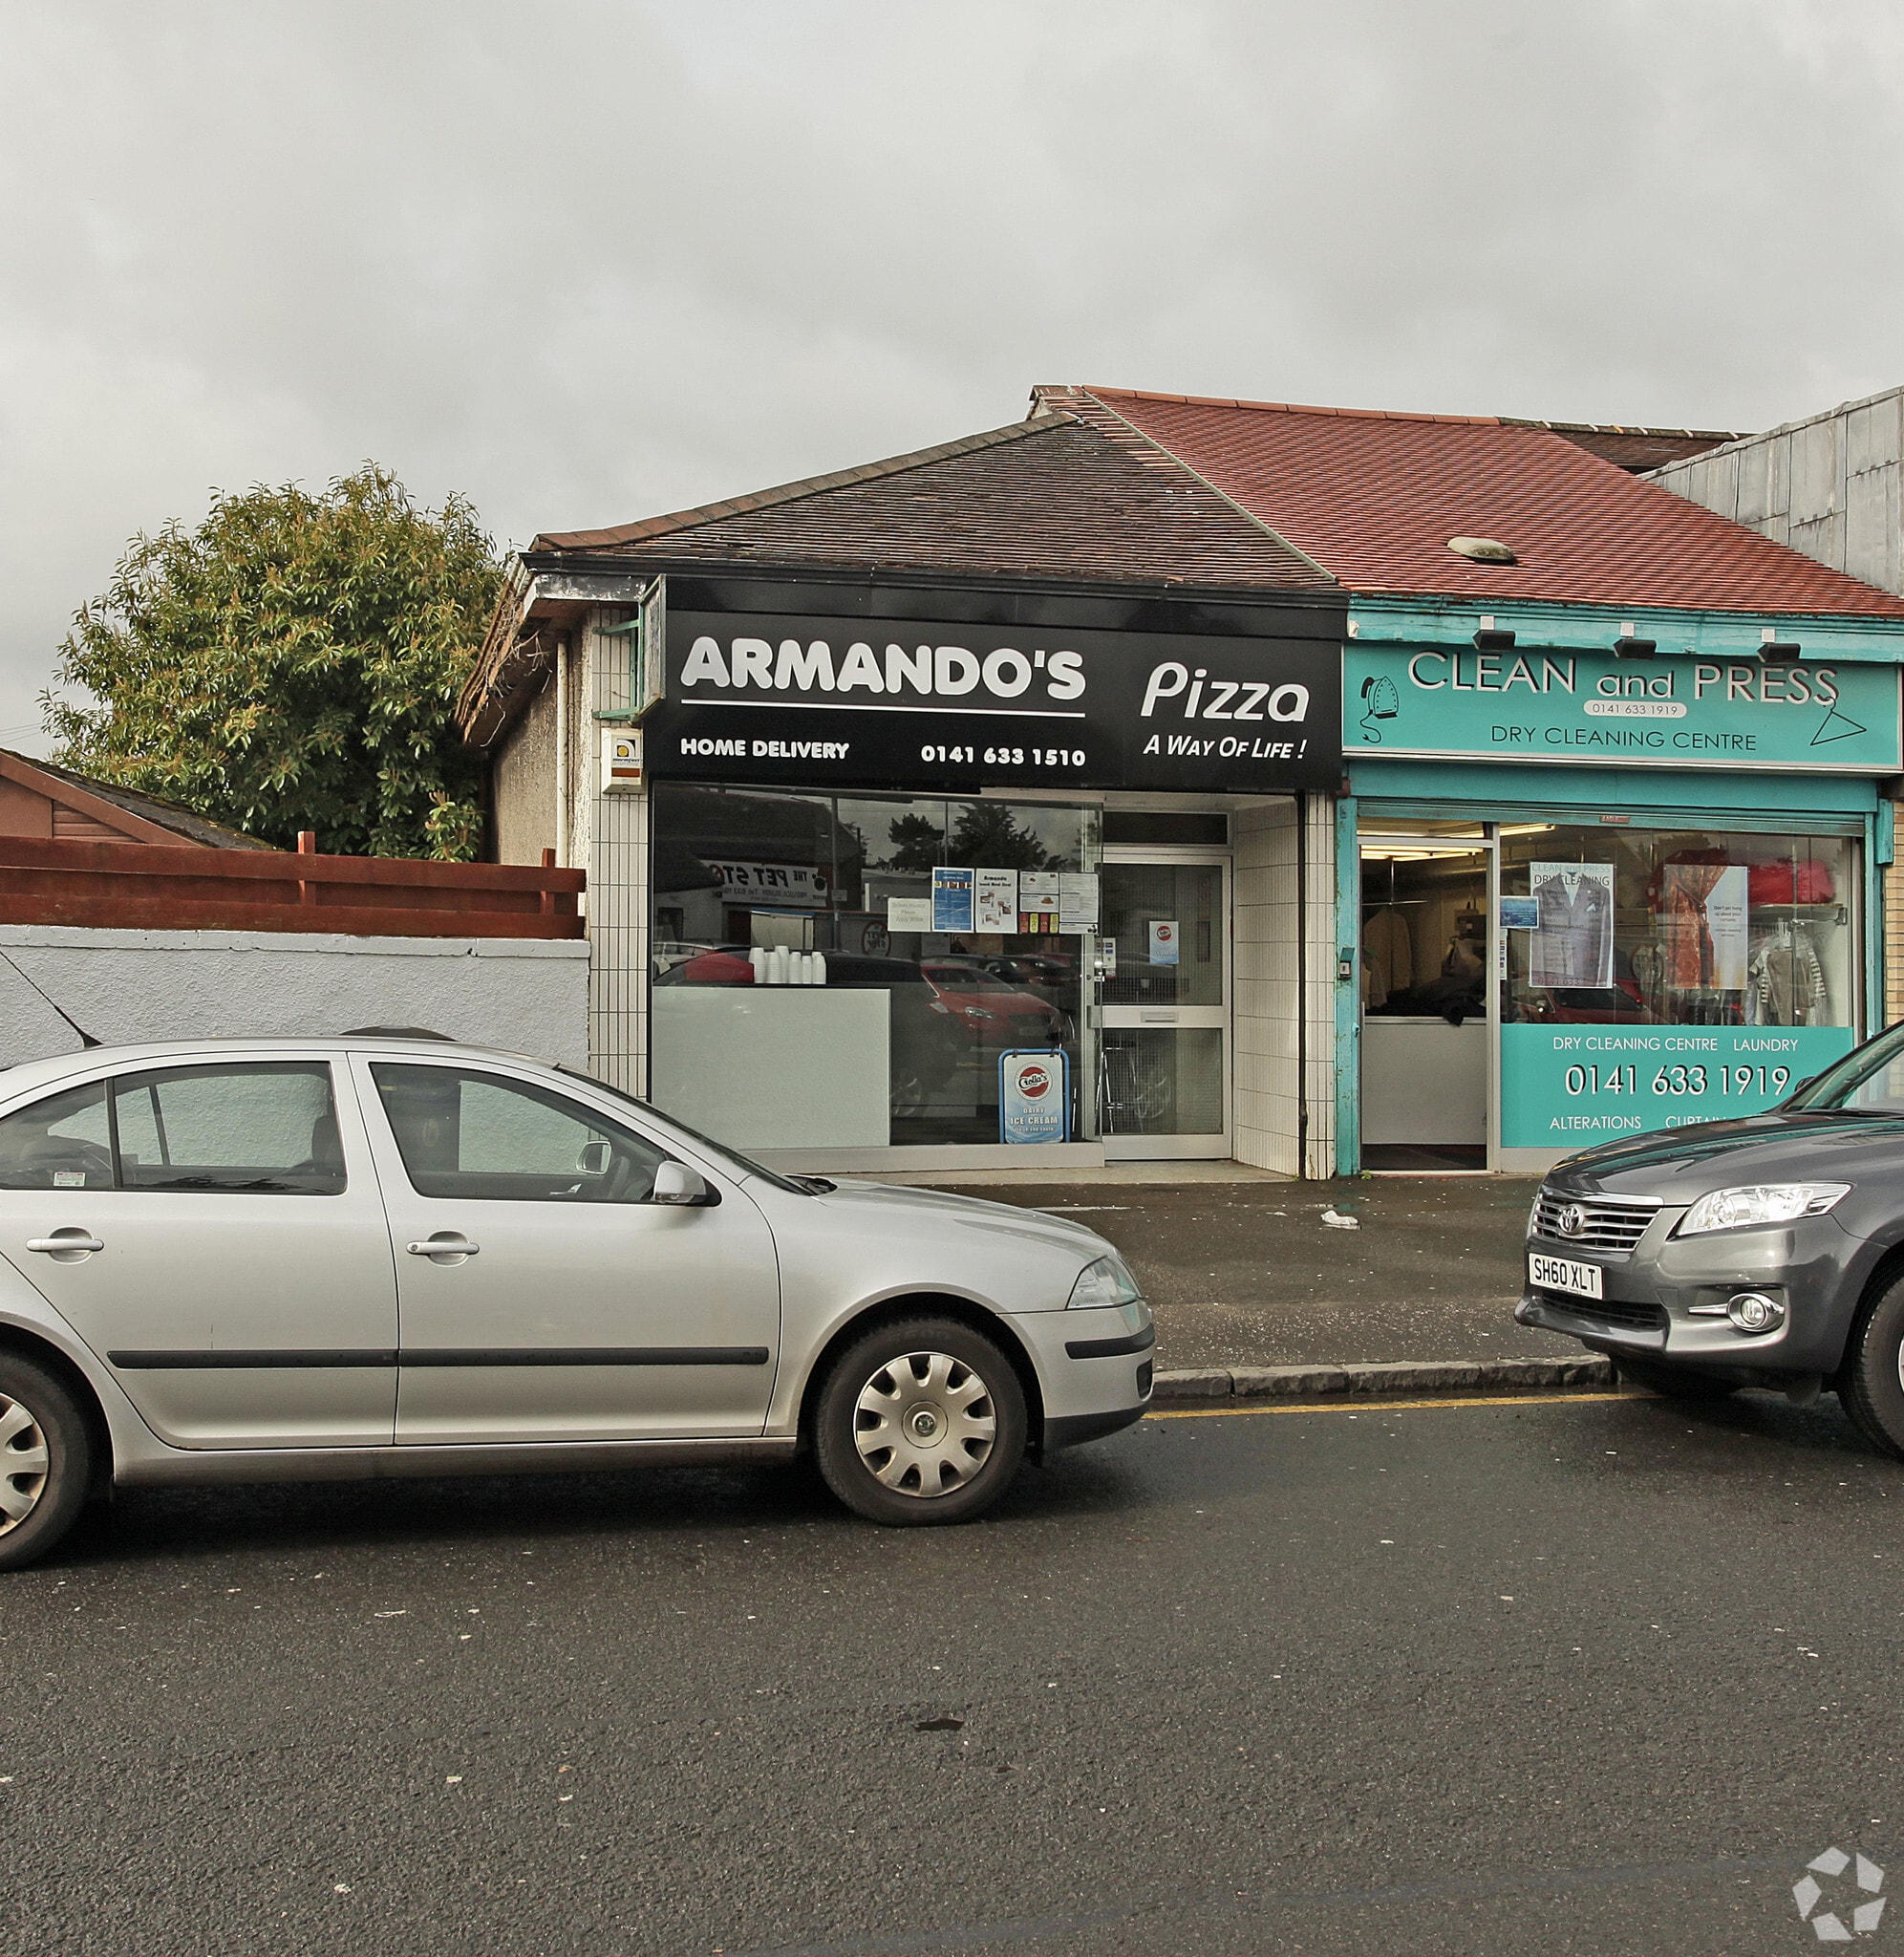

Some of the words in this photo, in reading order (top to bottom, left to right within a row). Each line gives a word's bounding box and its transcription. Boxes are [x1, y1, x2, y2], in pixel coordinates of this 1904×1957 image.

[680, 635, 1086, 700] ARMANDO'S
[1408, 651, 1576, 695] CLEAN
[1596, 671, 1674, 699] and
[1695, 664, 1839, 705] PRESS
[1140, 661, 1310, 722] Pizza
[1592, 703, 1620, 714] 0141
[1625, 704, 1647, 715] 633
[1651, 705, 1679, 716] 1919
[1143, 734, 1160, 755] A
[1491, 725, 1536, 742] DRY
[1545, 727, 1665, 748] CLEANING
[1673, 731, 1757, 751] CENTRE
[680, 738, 746, 757] HOME
[752, 740, 850, 760] DELIVERY
[921, 744, 973, 763] 0141
[983, 747, 1025, 765] 633
[1032, 748, 1086, 767] 1510
[1531, 863, 1562, 872] CLEAN
[1563, 863, 1581, 872] and
[1584, 864, 1611, 873] PRESS
[1534, 874, 1557, 885] DRY
[1558, 874, 1610, 887] CLEANING
[1562, 977, 1580, 987] 633
[1552, 1037, 1582, 1050] DRY
[1585, 1037, 1661, 1051] CLEANING
[1665, 1038, 1718, 1051] CENTRE
[1733, 1039, 1799, 1052] LAUNDRY
[1565, 1064, 1637, 1095] 0141
[1651, 1065, 1708, 1096] 633
[1720, 1065, 1791, 1096] 1919
[1010, 1116, 1024, 1125] ICE
[1028, 1115, 1059, 1125] CREAM
[1550, 1115, 1642, 1129] ALTERATIONS
[1534, 1258, 1568, 1286] SH60
[1571, 1264, 1596, 1292] XLT
